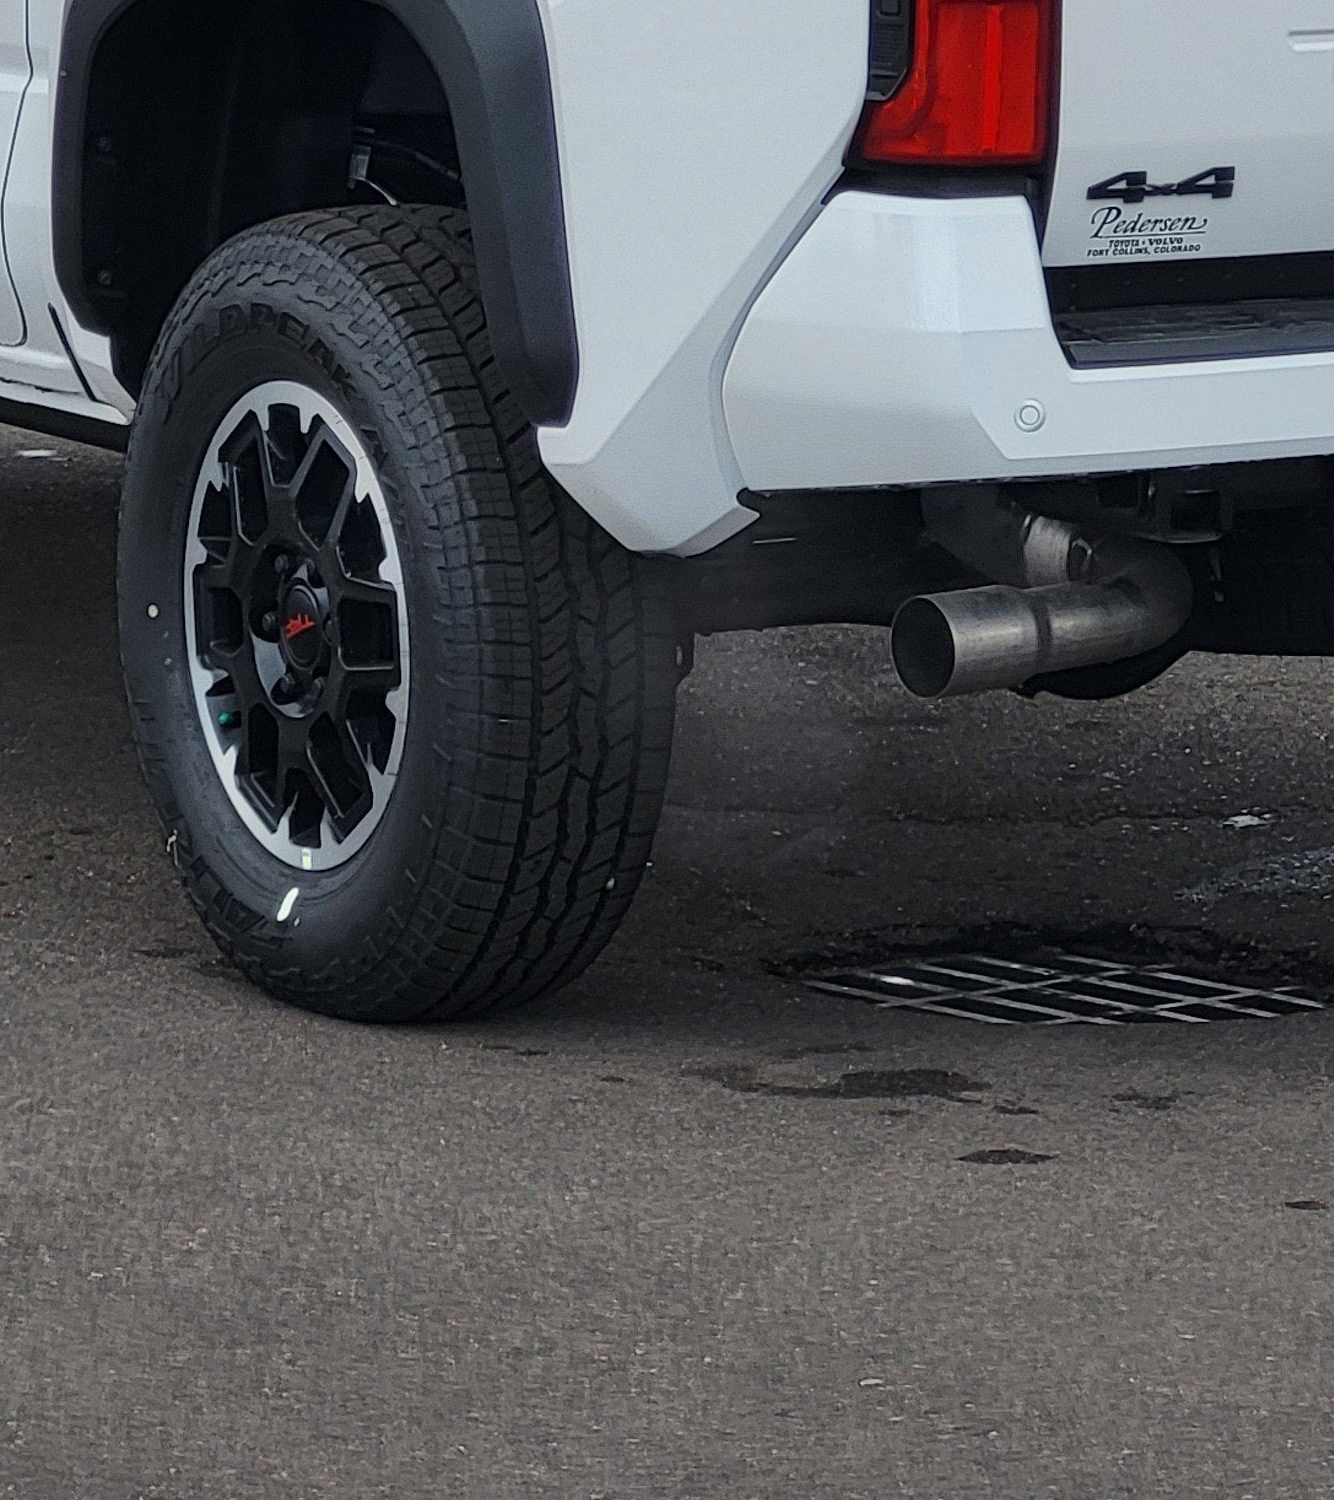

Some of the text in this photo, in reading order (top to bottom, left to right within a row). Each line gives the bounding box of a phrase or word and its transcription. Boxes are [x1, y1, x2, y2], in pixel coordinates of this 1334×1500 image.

[1089, 206, 1208, 239] Pedersen
[1109, 236, 1184, 249] TOYOTA VOLVO
[1087, 248, 1110, 258] FORT
